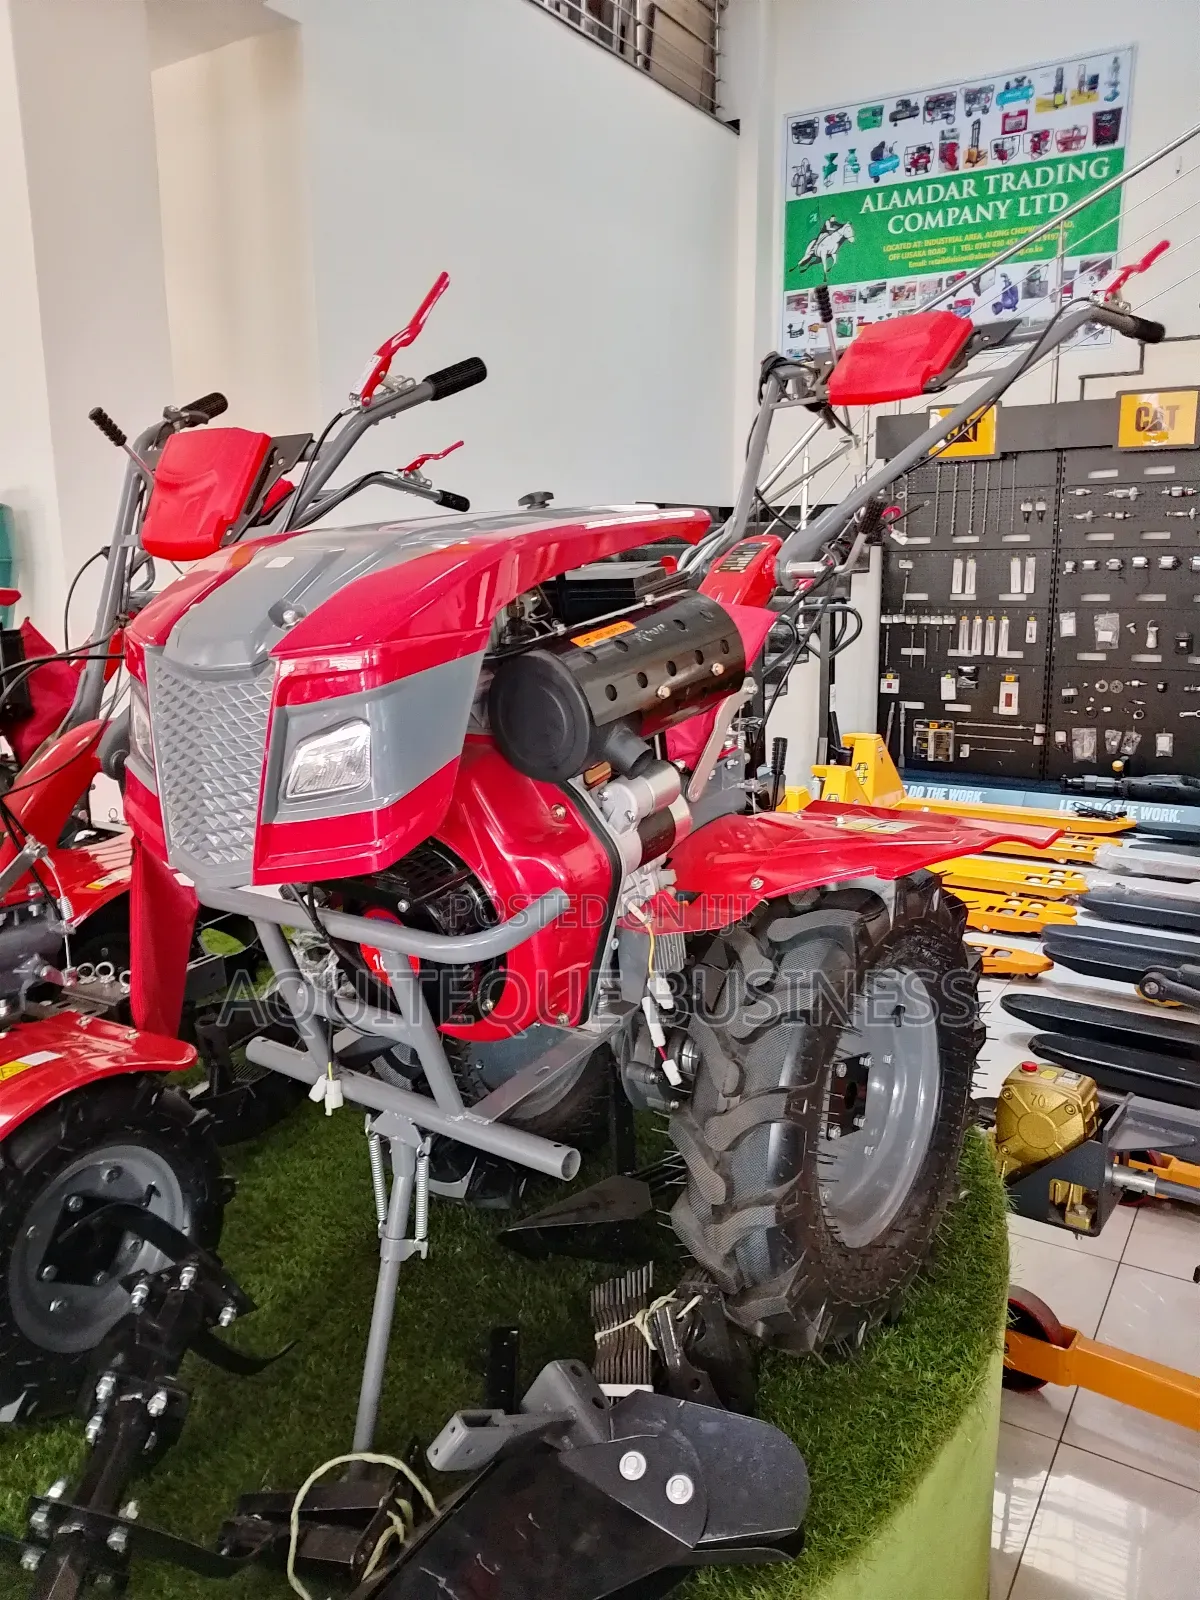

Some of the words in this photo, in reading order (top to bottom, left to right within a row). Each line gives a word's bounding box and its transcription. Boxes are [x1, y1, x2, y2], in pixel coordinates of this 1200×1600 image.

[859, 183, 976, 214] ALAMDAR
[983, 157, 1110, 196] TRADING
[888, 199, 1012, 235] COMPANY
[1018, 192, 1069, 217] LTD
[883, 241, 912, 252] LOCATED
[924, 236, 963, 247] INDUSTRIAL
[985, 229, 1010, 239] ALONG
[901, 250, 927, 259] LUSAKA
[927, 247, 947, 256] ROAD
[1135, 404, 1180, 432] CAT
[908, 785, 924, 798] DO
[926, 787, 948, 800] THE
